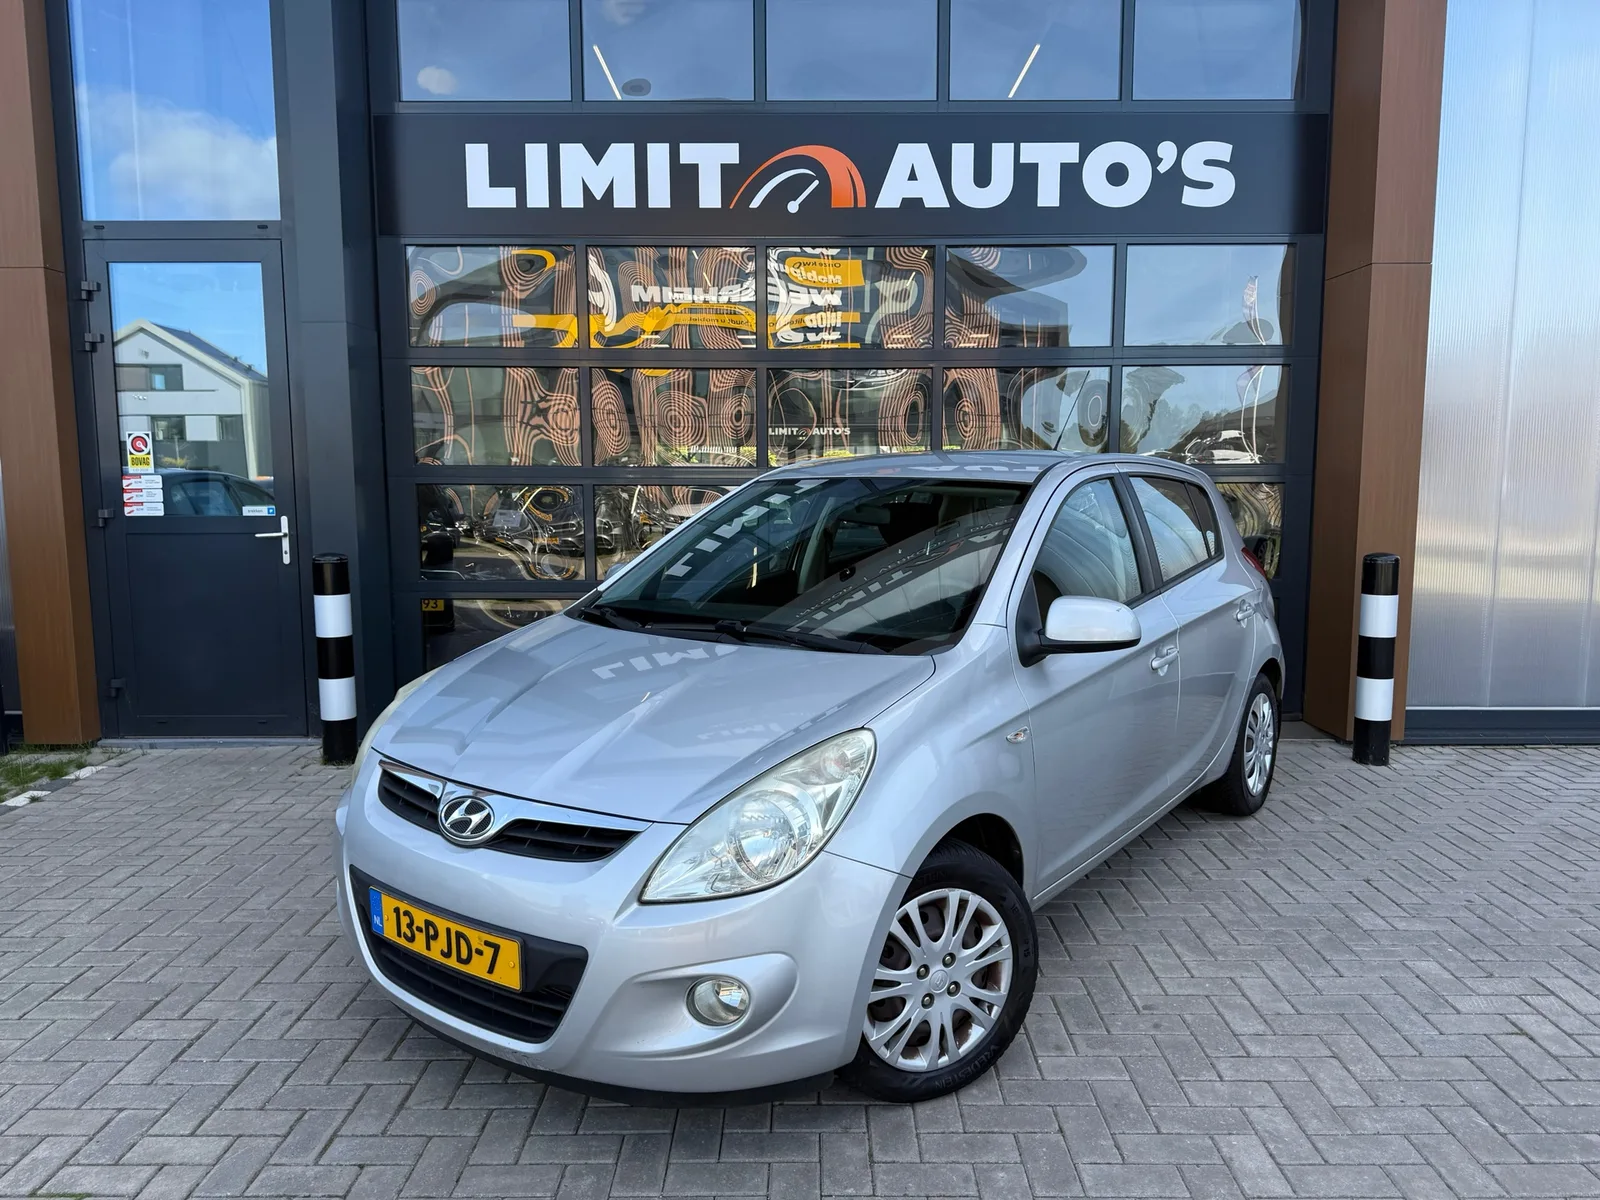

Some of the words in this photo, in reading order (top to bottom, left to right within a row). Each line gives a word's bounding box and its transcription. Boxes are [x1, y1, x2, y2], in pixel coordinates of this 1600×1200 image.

[464, 143, 740, 209] LIMIT
[874, 139, 1237, 209] AUTO'S
[768, 427, 799, 436] LIMIT
[812, 427, 851, 436] AUTO'S
[130, 455, 151, 467] BOVAG
[373, 914, 383, 928] NL
[393, 906, 501, 975] 13-PJD-7
